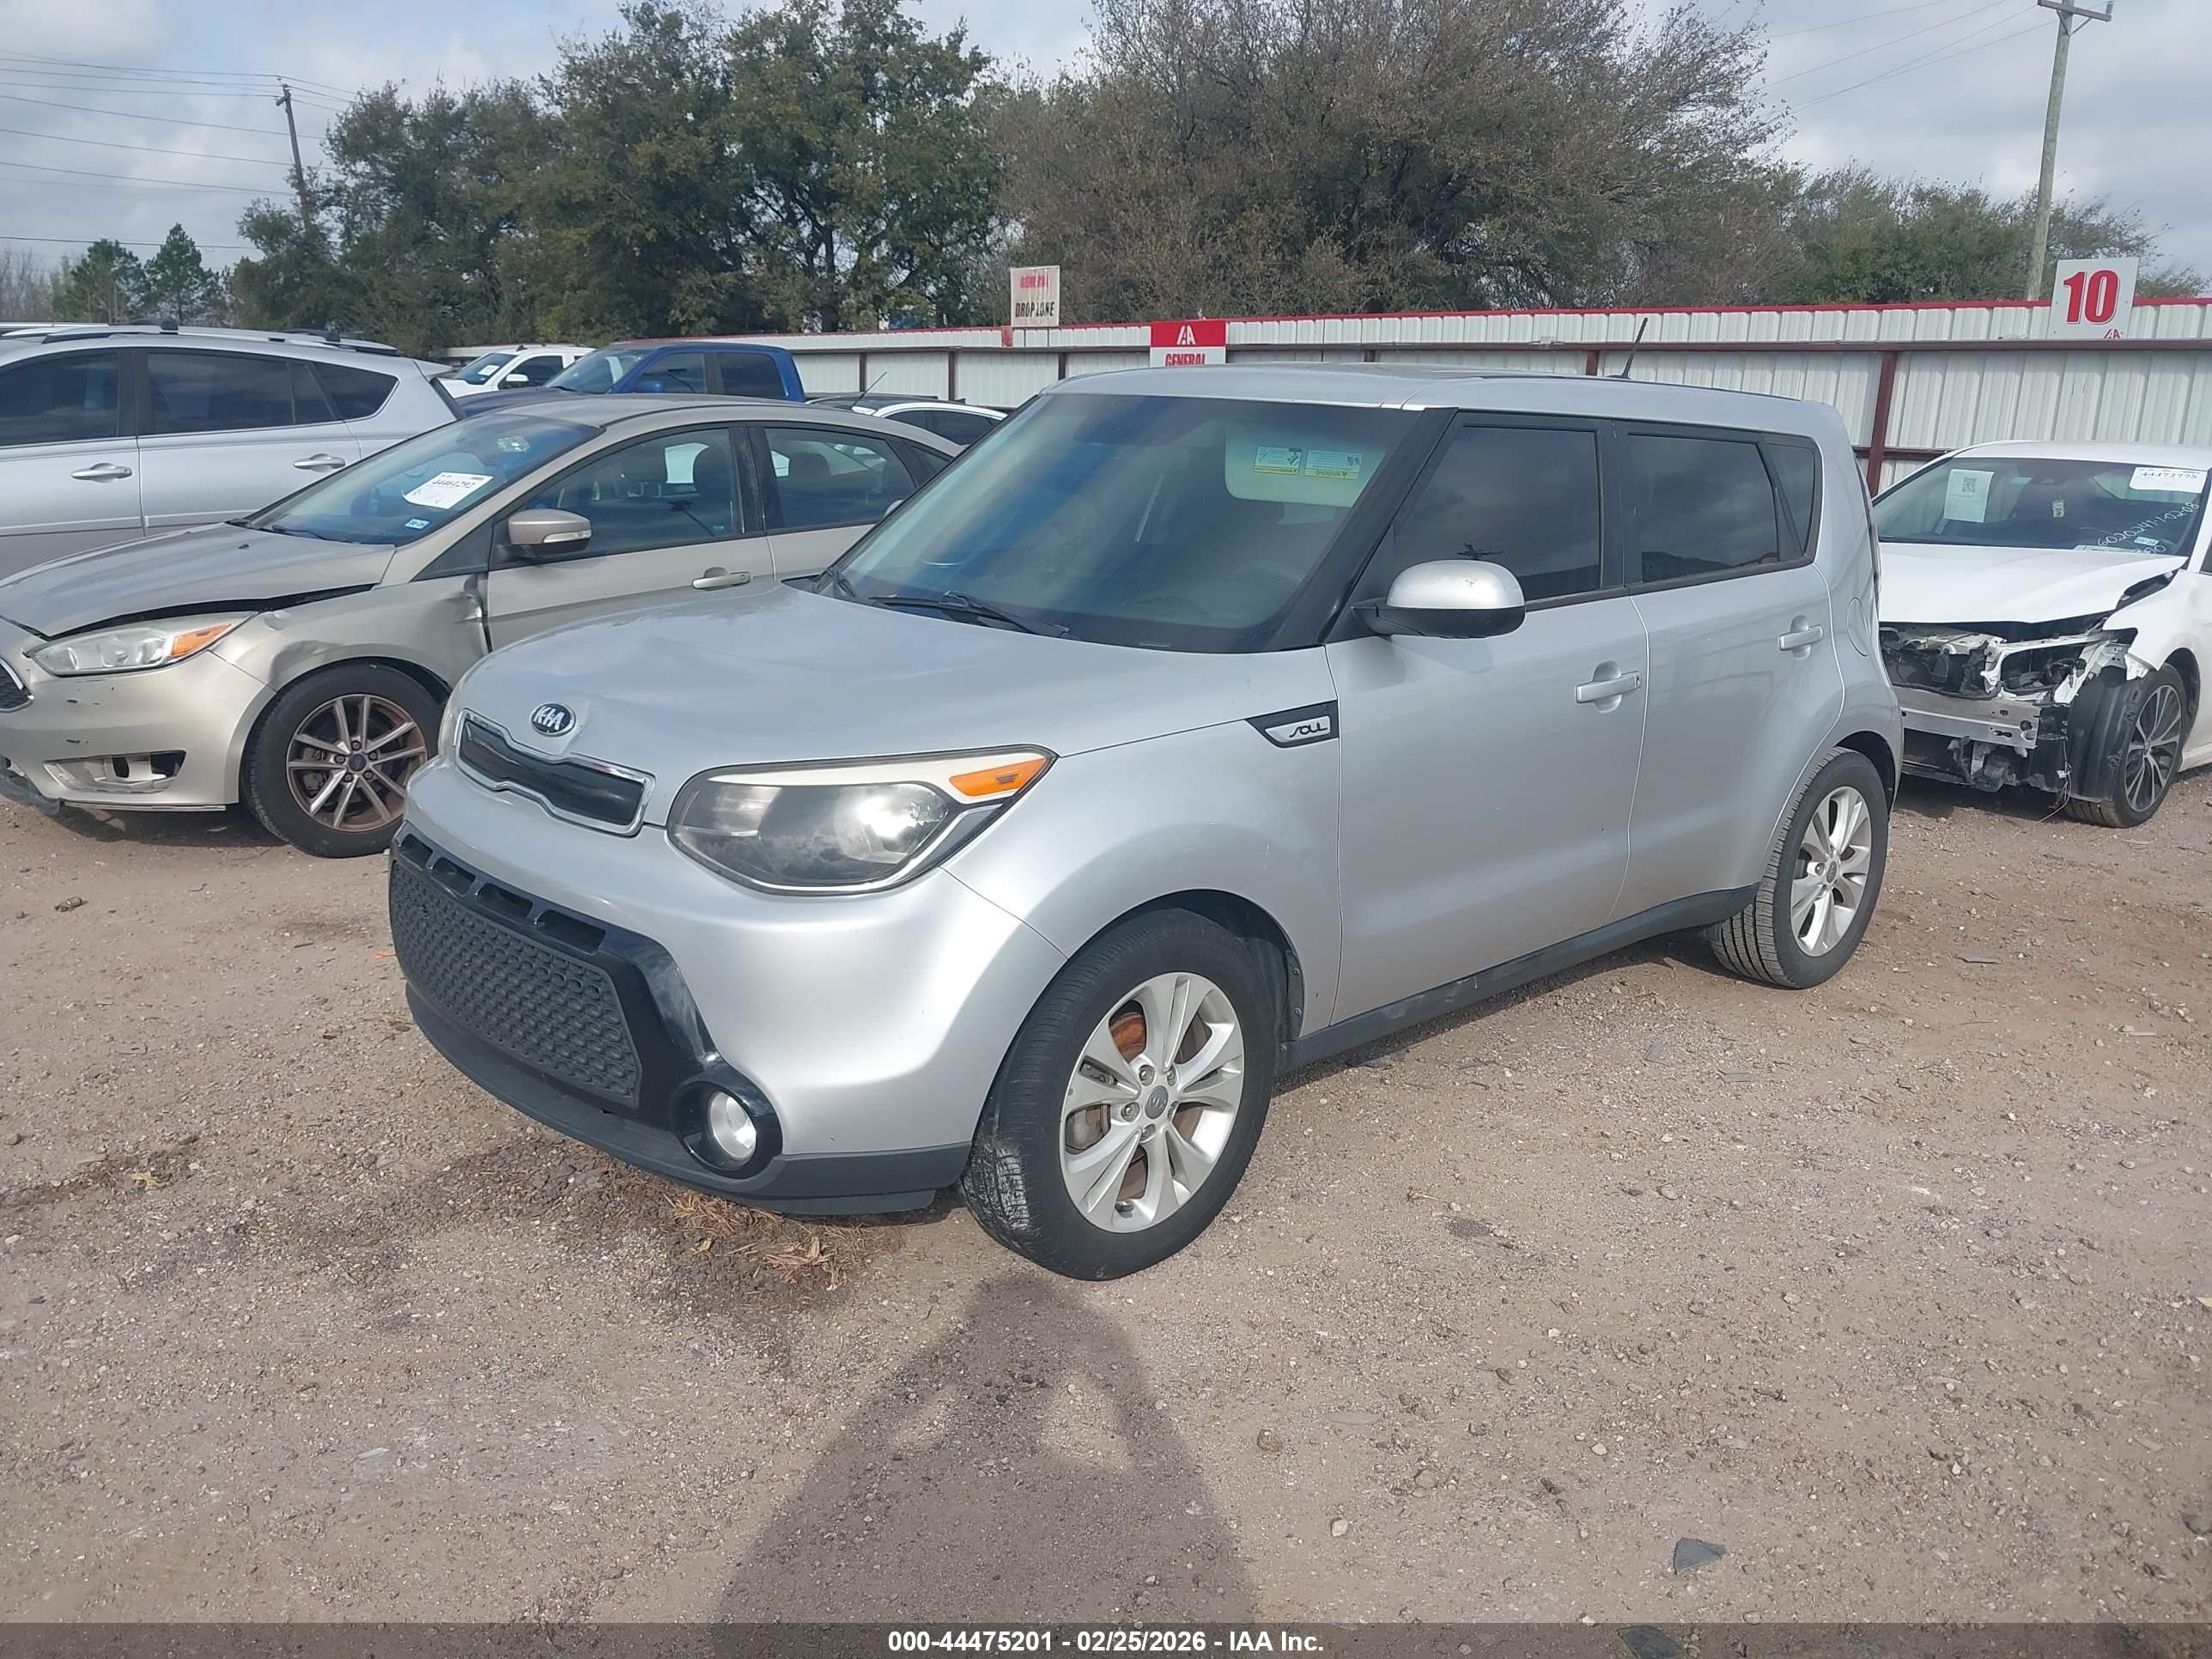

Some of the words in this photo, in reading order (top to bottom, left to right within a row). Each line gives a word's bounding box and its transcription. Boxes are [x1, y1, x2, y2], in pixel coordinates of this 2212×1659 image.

[2063, 269, 2119, 324] 10
[1015, 301, 1035, 318] DROP
[532, 705, 566, 731] KIA
[1289, 722, 1328, 738] SOUL
